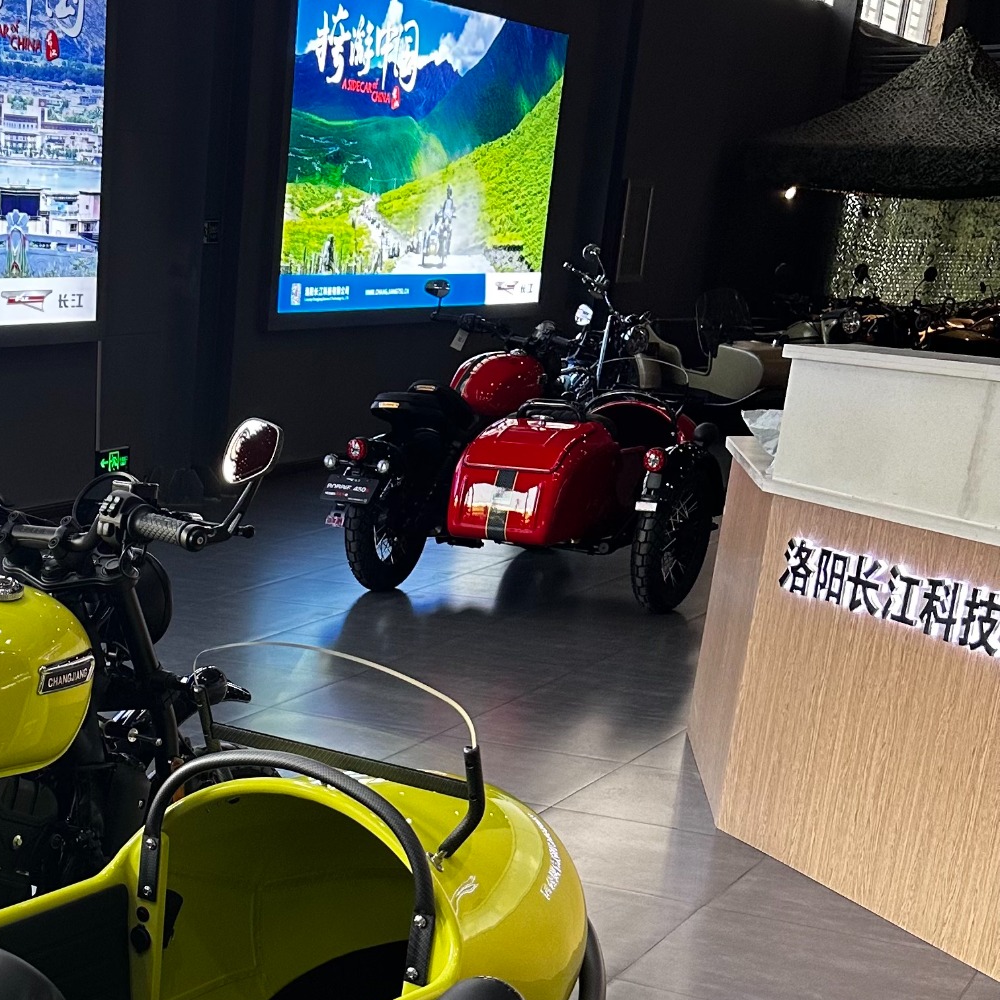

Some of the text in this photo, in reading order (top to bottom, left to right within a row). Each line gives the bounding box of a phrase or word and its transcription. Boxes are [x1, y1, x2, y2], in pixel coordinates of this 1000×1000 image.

[10, 36, 42, 53] CHINA
[348, 80, 373, 93] SIDECAR
[371, 91, 390, 103] CHINA
[58, 294, 84, 308] 长江
[778, 537, 1000, 657] 洛阳长江科技
[47, 667, 88, 688] CHANGJIANG
